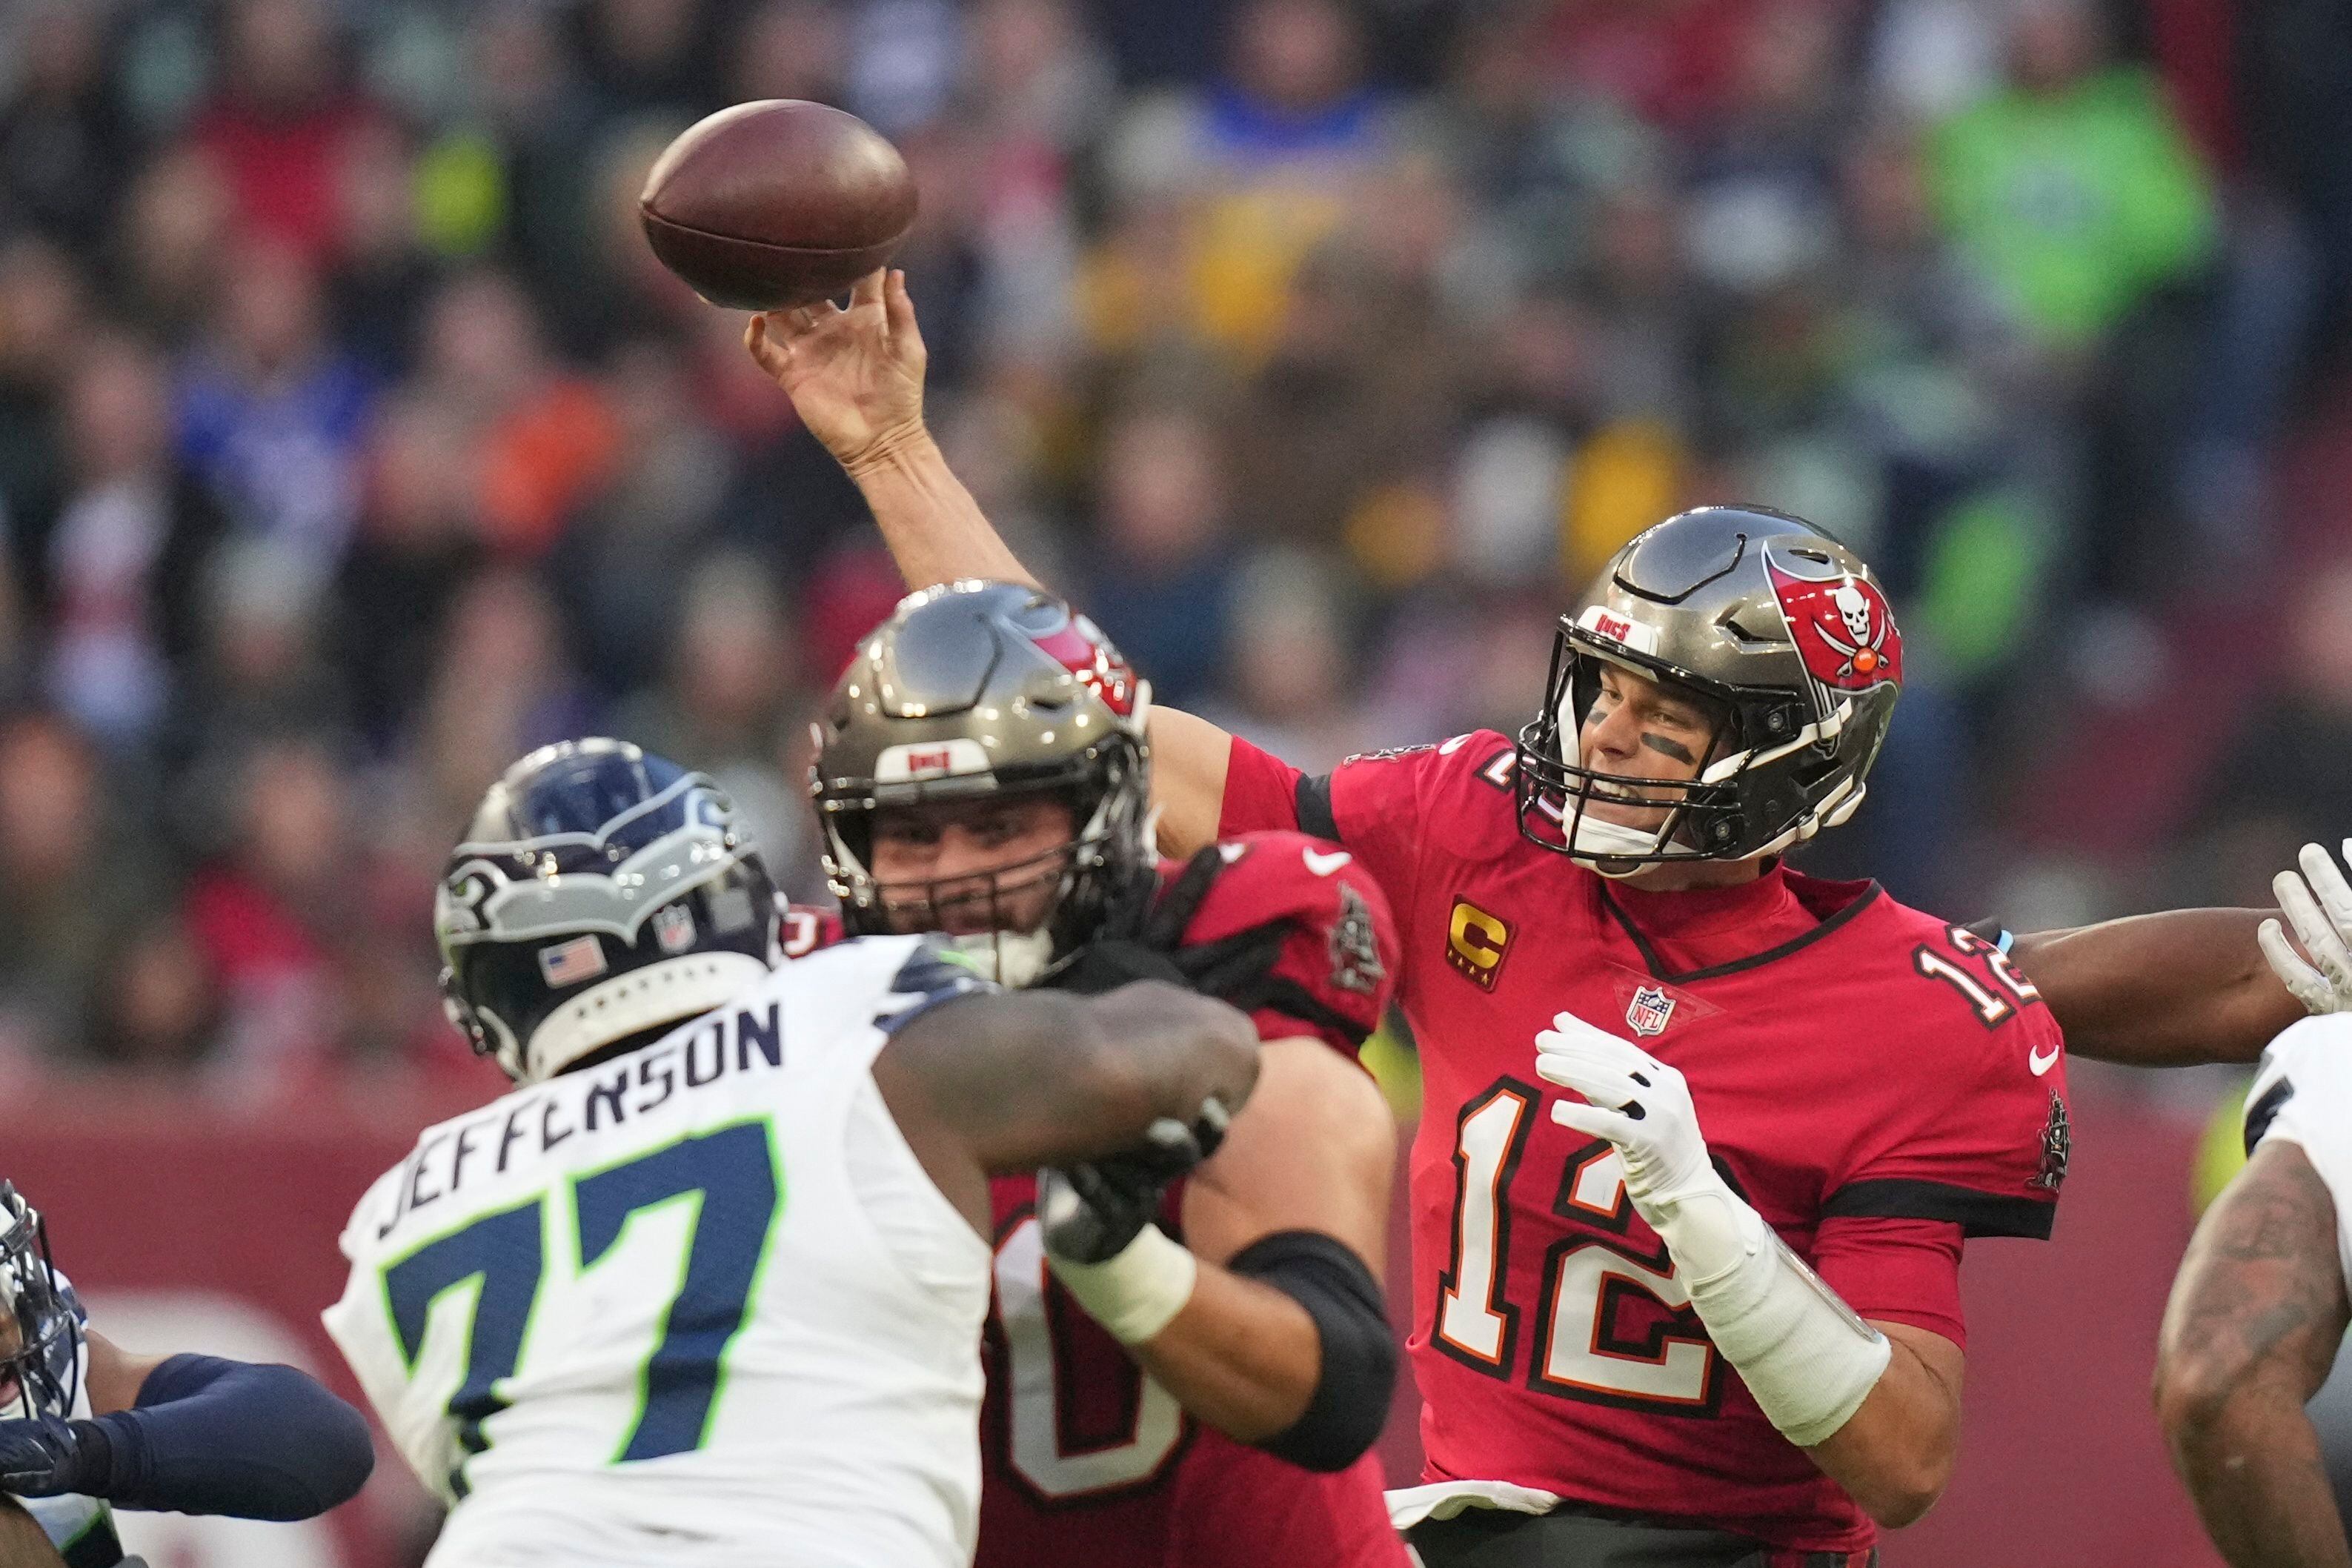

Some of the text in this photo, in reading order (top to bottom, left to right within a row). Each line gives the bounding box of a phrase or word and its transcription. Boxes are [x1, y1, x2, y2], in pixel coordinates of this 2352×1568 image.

[1449, 903, 1506, 969] C
[1913, 925, 2043, 1031] 12
[1632, 1005, 1659, 1029] NFL
[1430, 1073, 1727, 1420] 12
[376, 1114, 787, 1503] 77
